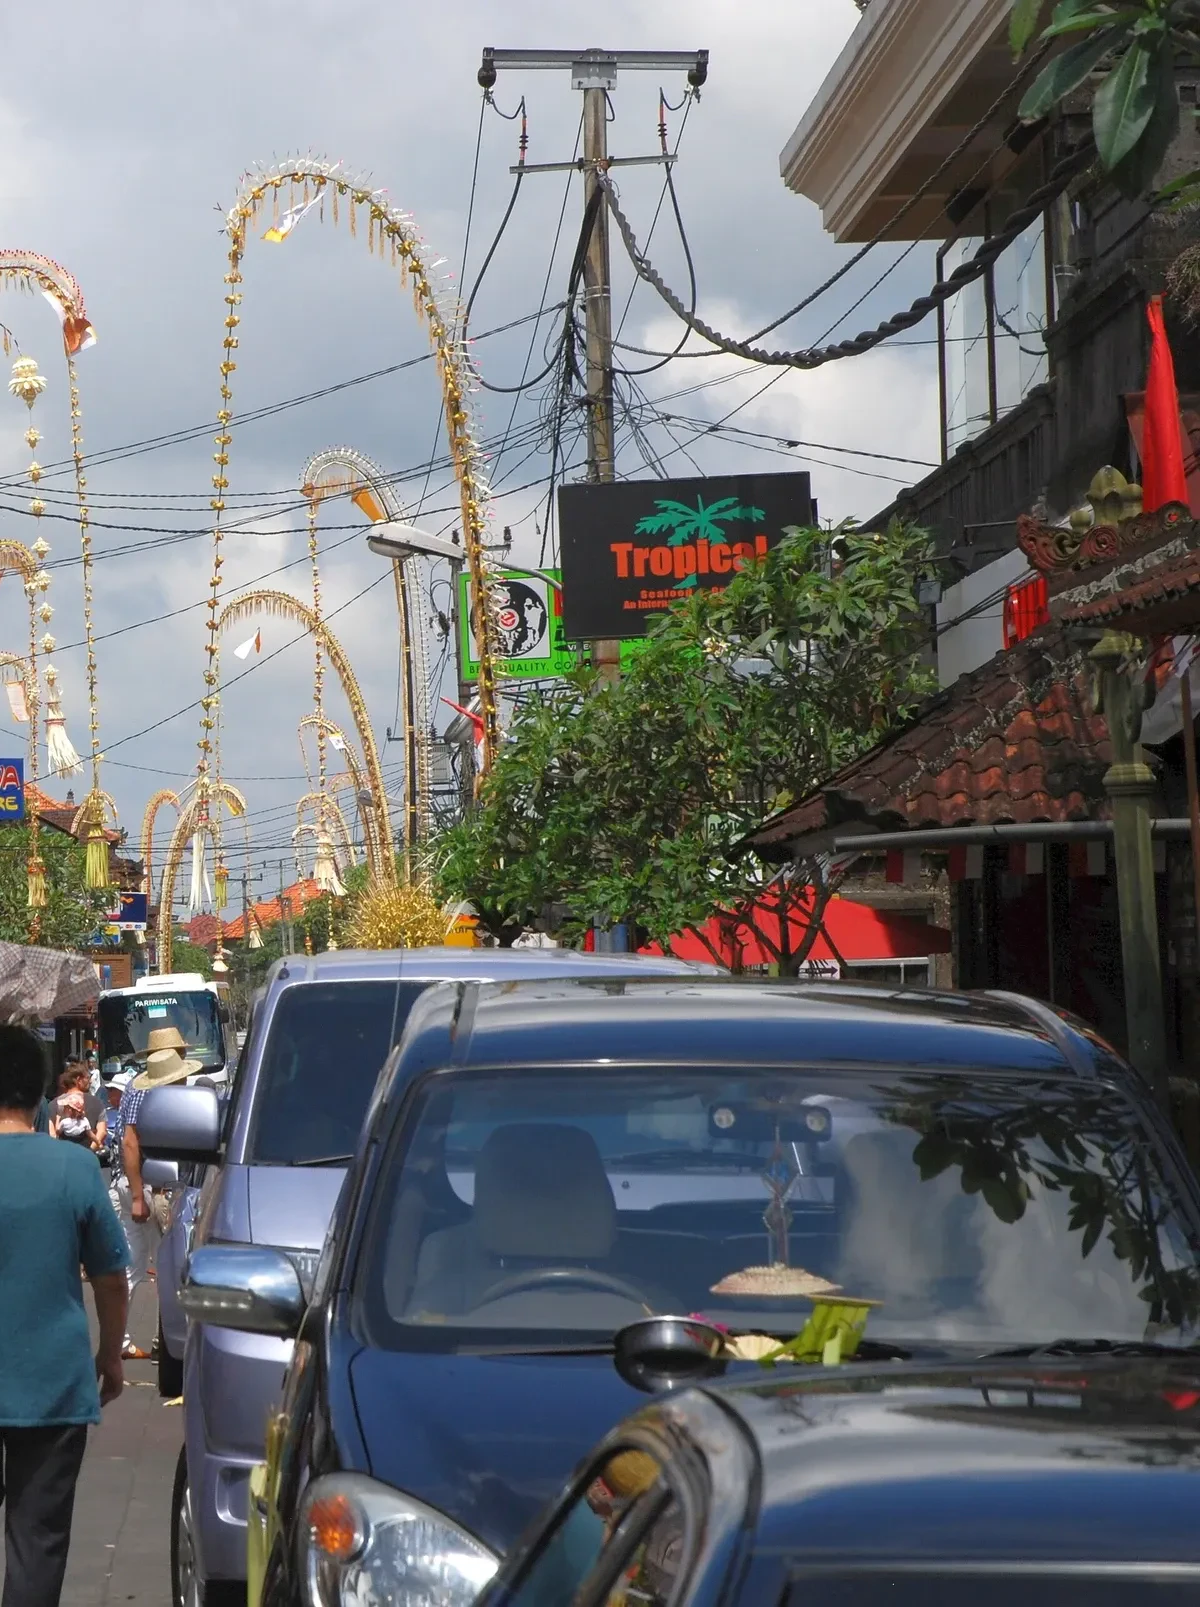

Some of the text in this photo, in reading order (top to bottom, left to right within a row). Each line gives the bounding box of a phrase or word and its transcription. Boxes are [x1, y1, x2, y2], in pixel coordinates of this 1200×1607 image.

[610, 535, 768, 579] Tropical
[640, 588, 693, 599] Seafood
[134, 998, 178, 1008] PARIWISATA
